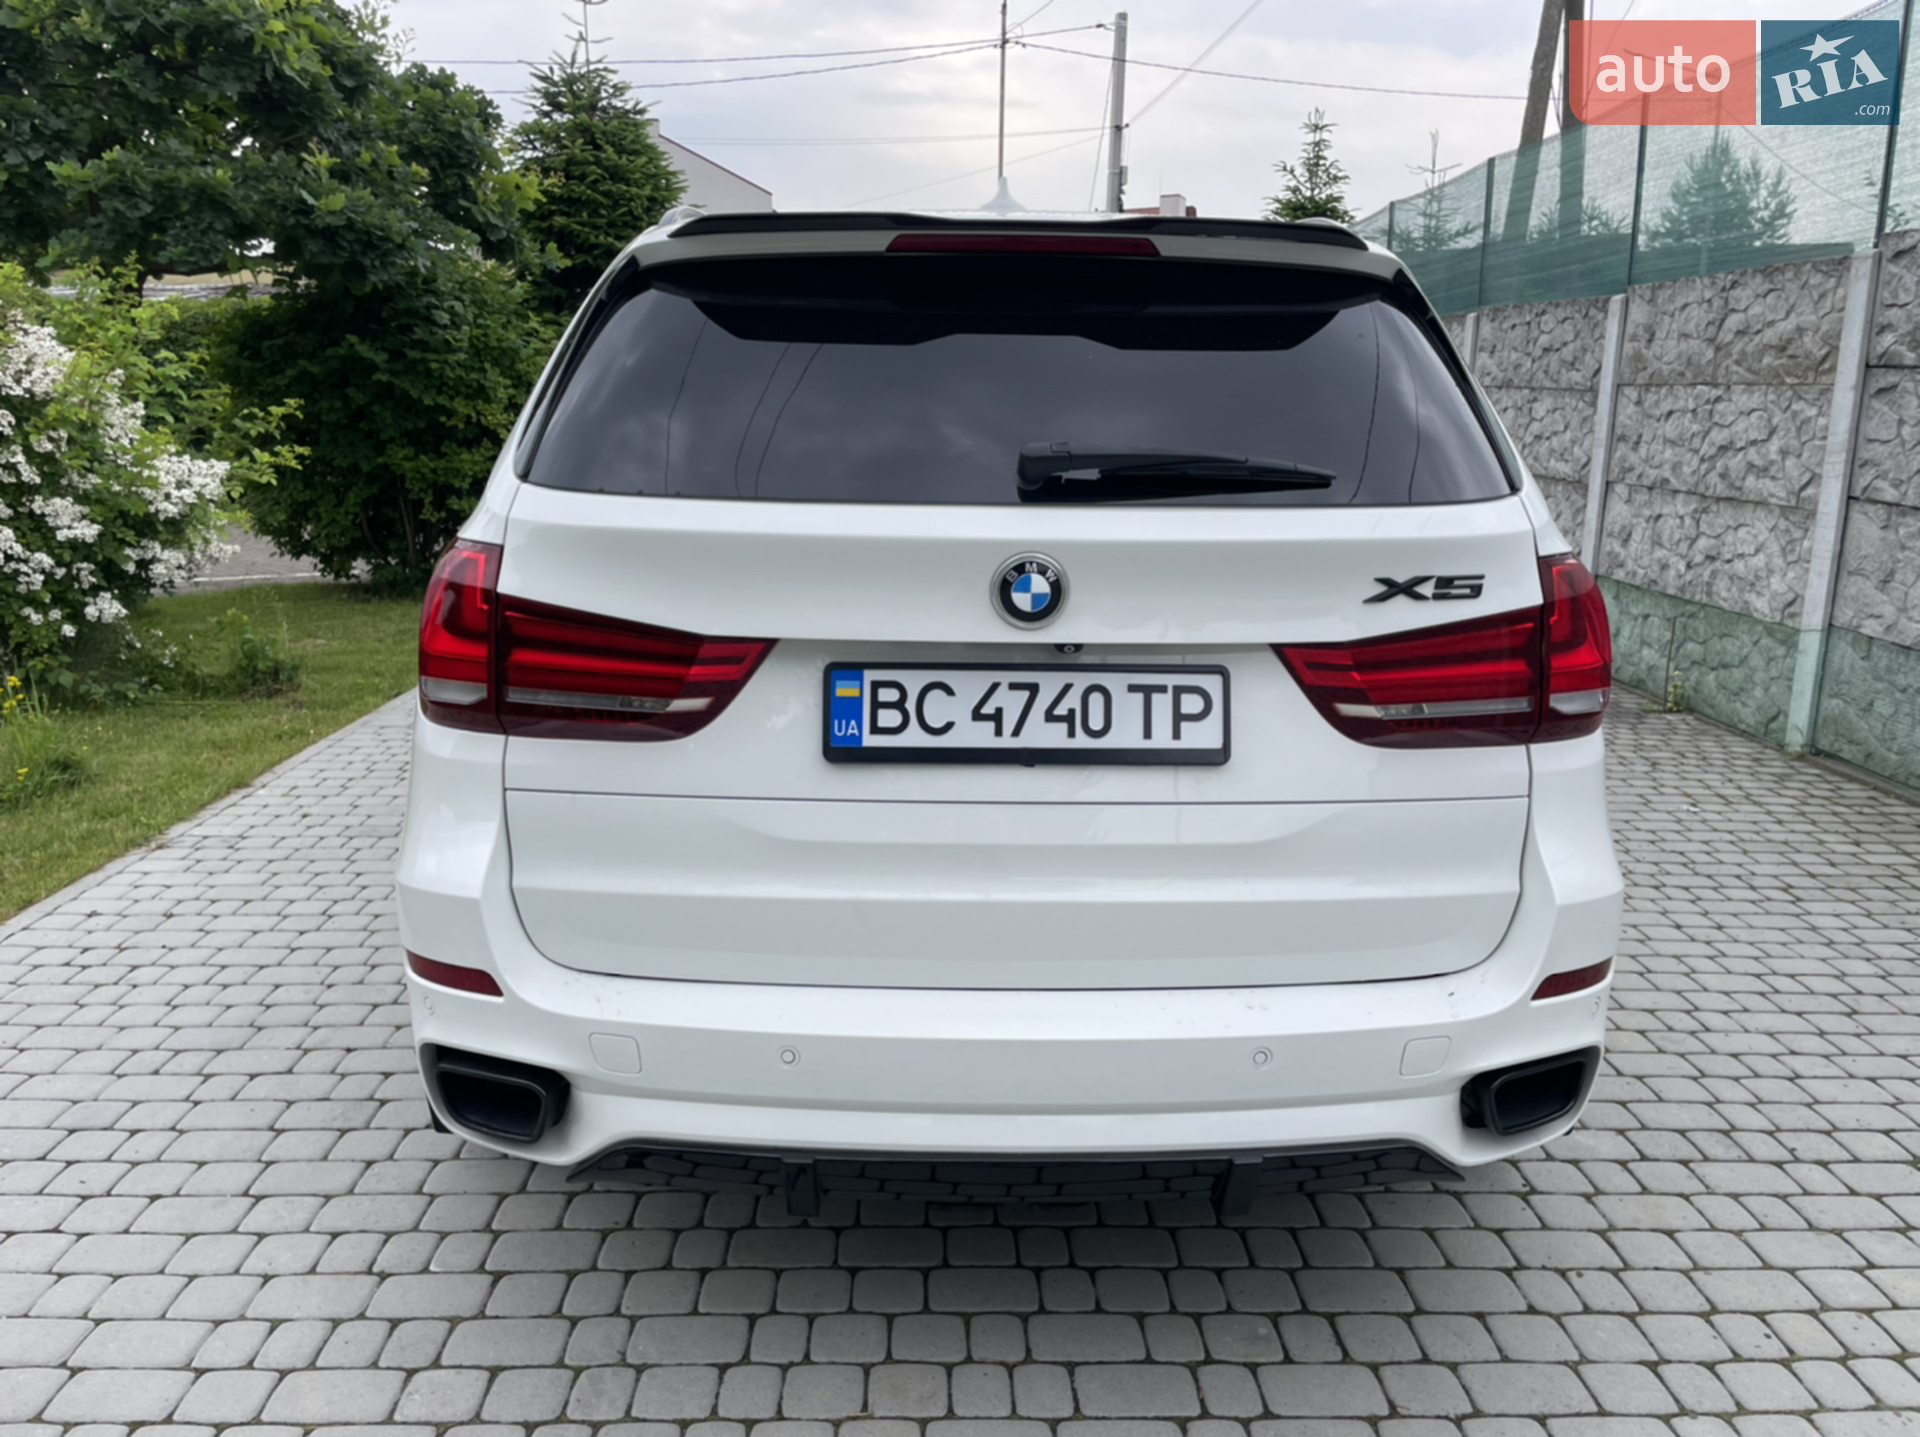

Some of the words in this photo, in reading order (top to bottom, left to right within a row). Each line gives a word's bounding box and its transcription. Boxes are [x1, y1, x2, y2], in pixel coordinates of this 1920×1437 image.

[1005, 562, 1058, 583] BMW
[1362, 574, 1485, 604] X5
[869, 680, 956, 736] BC
[971, 682, 1112, 739] 4740
[1127, 683, 1213, 741] TP
[834, 719, 859, 737] UA
